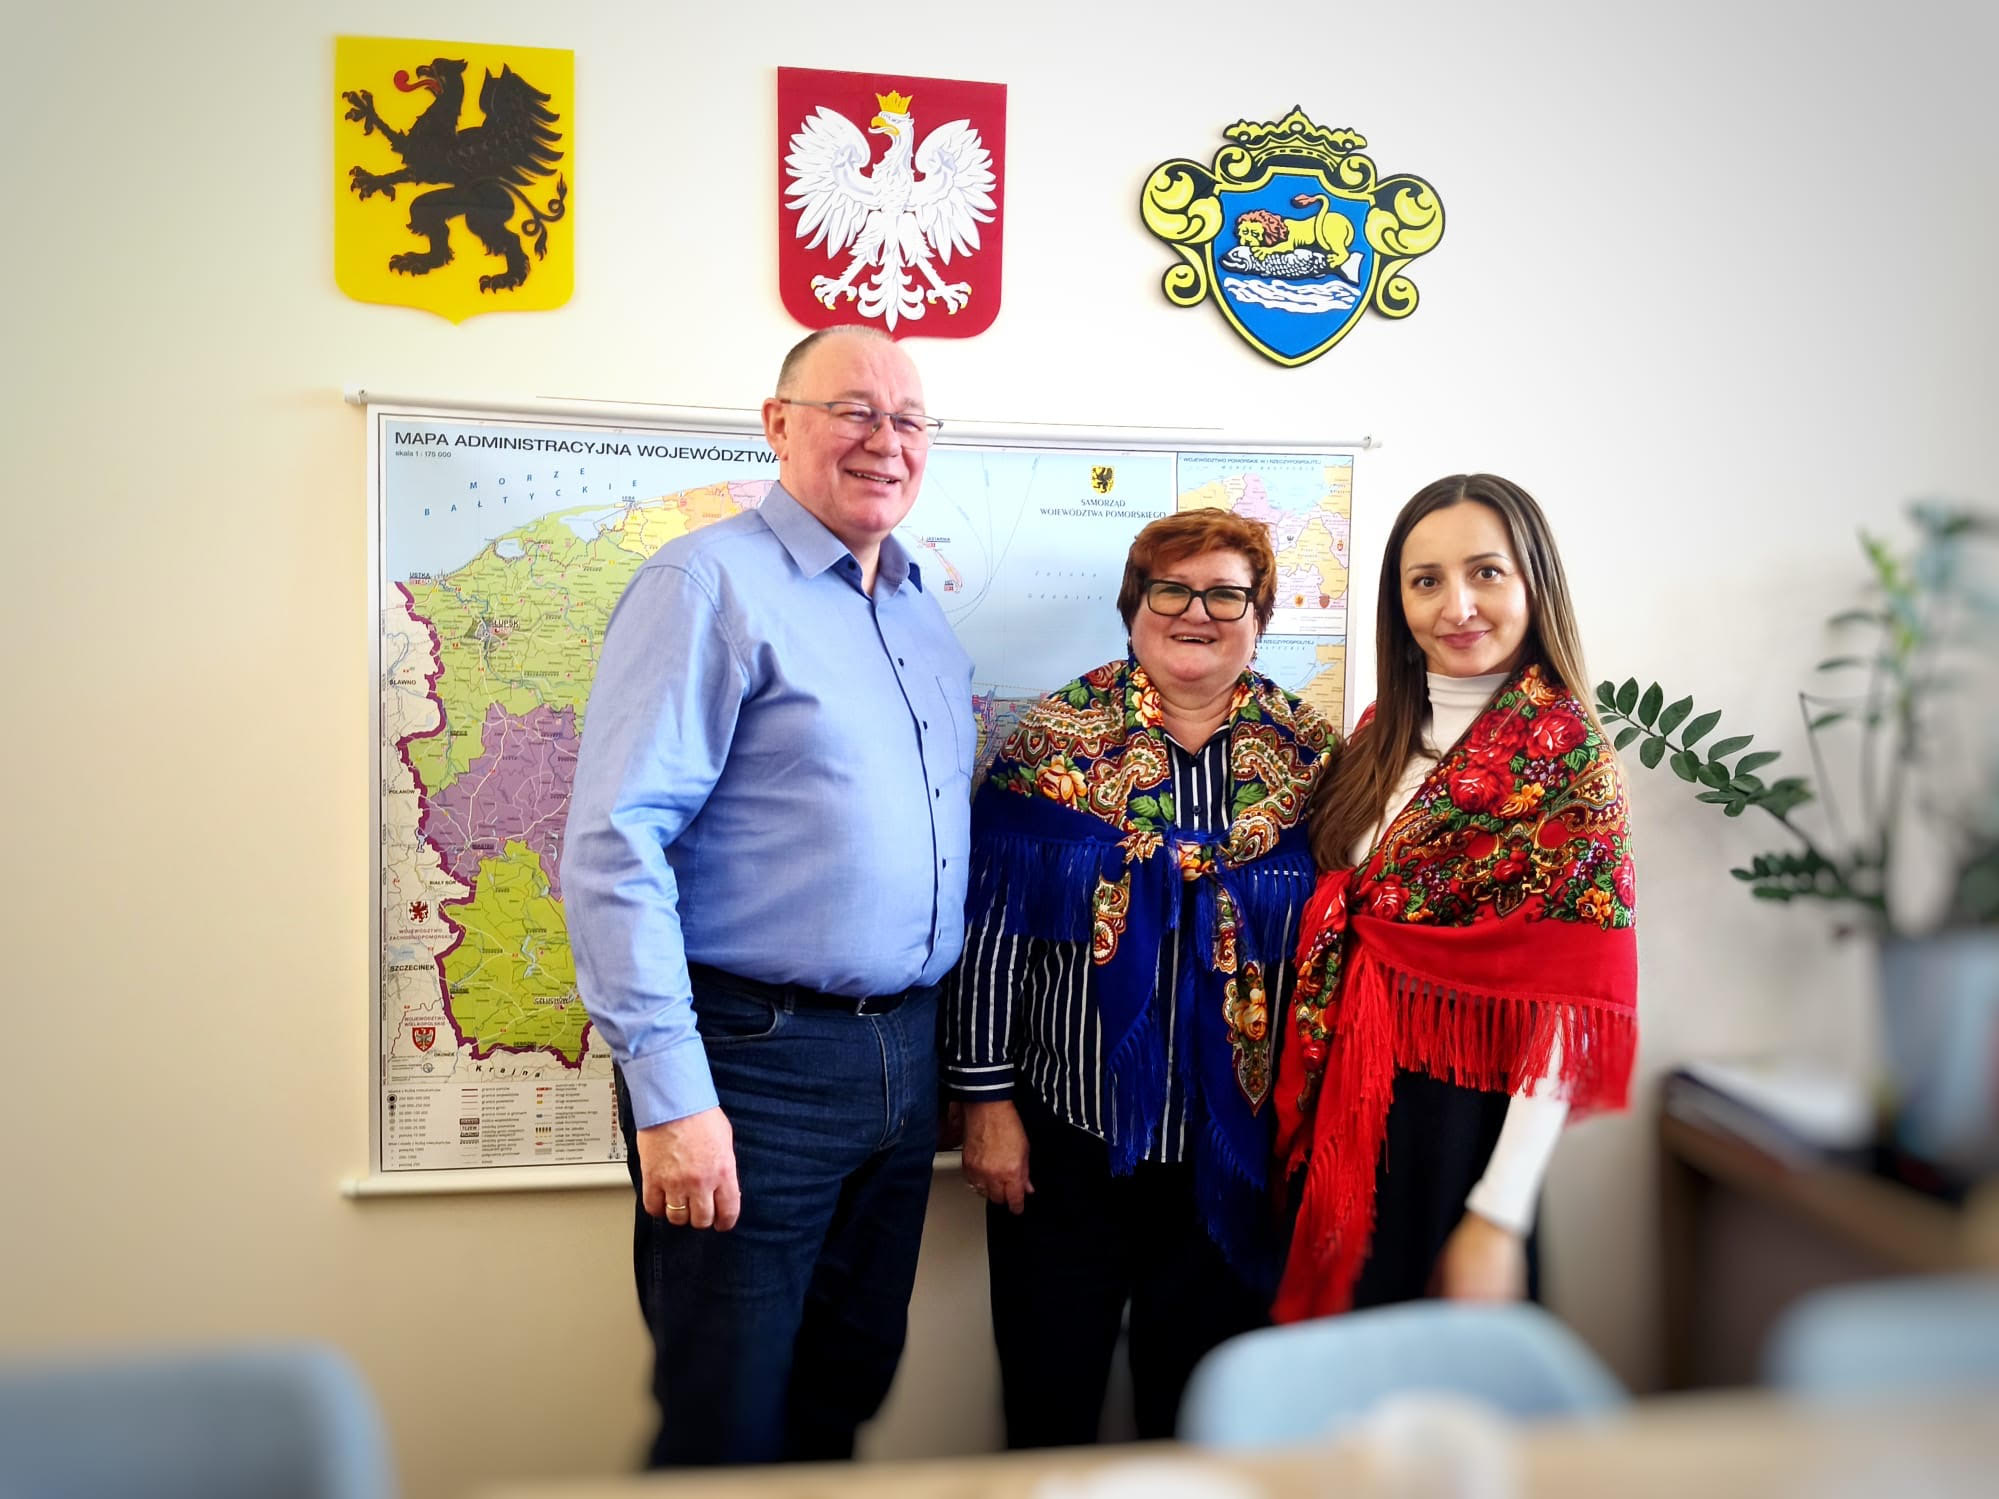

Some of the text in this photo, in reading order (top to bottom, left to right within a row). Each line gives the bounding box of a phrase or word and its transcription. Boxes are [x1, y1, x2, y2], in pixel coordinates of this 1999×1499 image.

[395, 432, 449, 446] MAPA
[454, 434, 632, 456] ADMINISTRACYJNA
[390, 964, 435, 972] SZCZECINEK
[475, 1065, 541, 1078] Krajna
